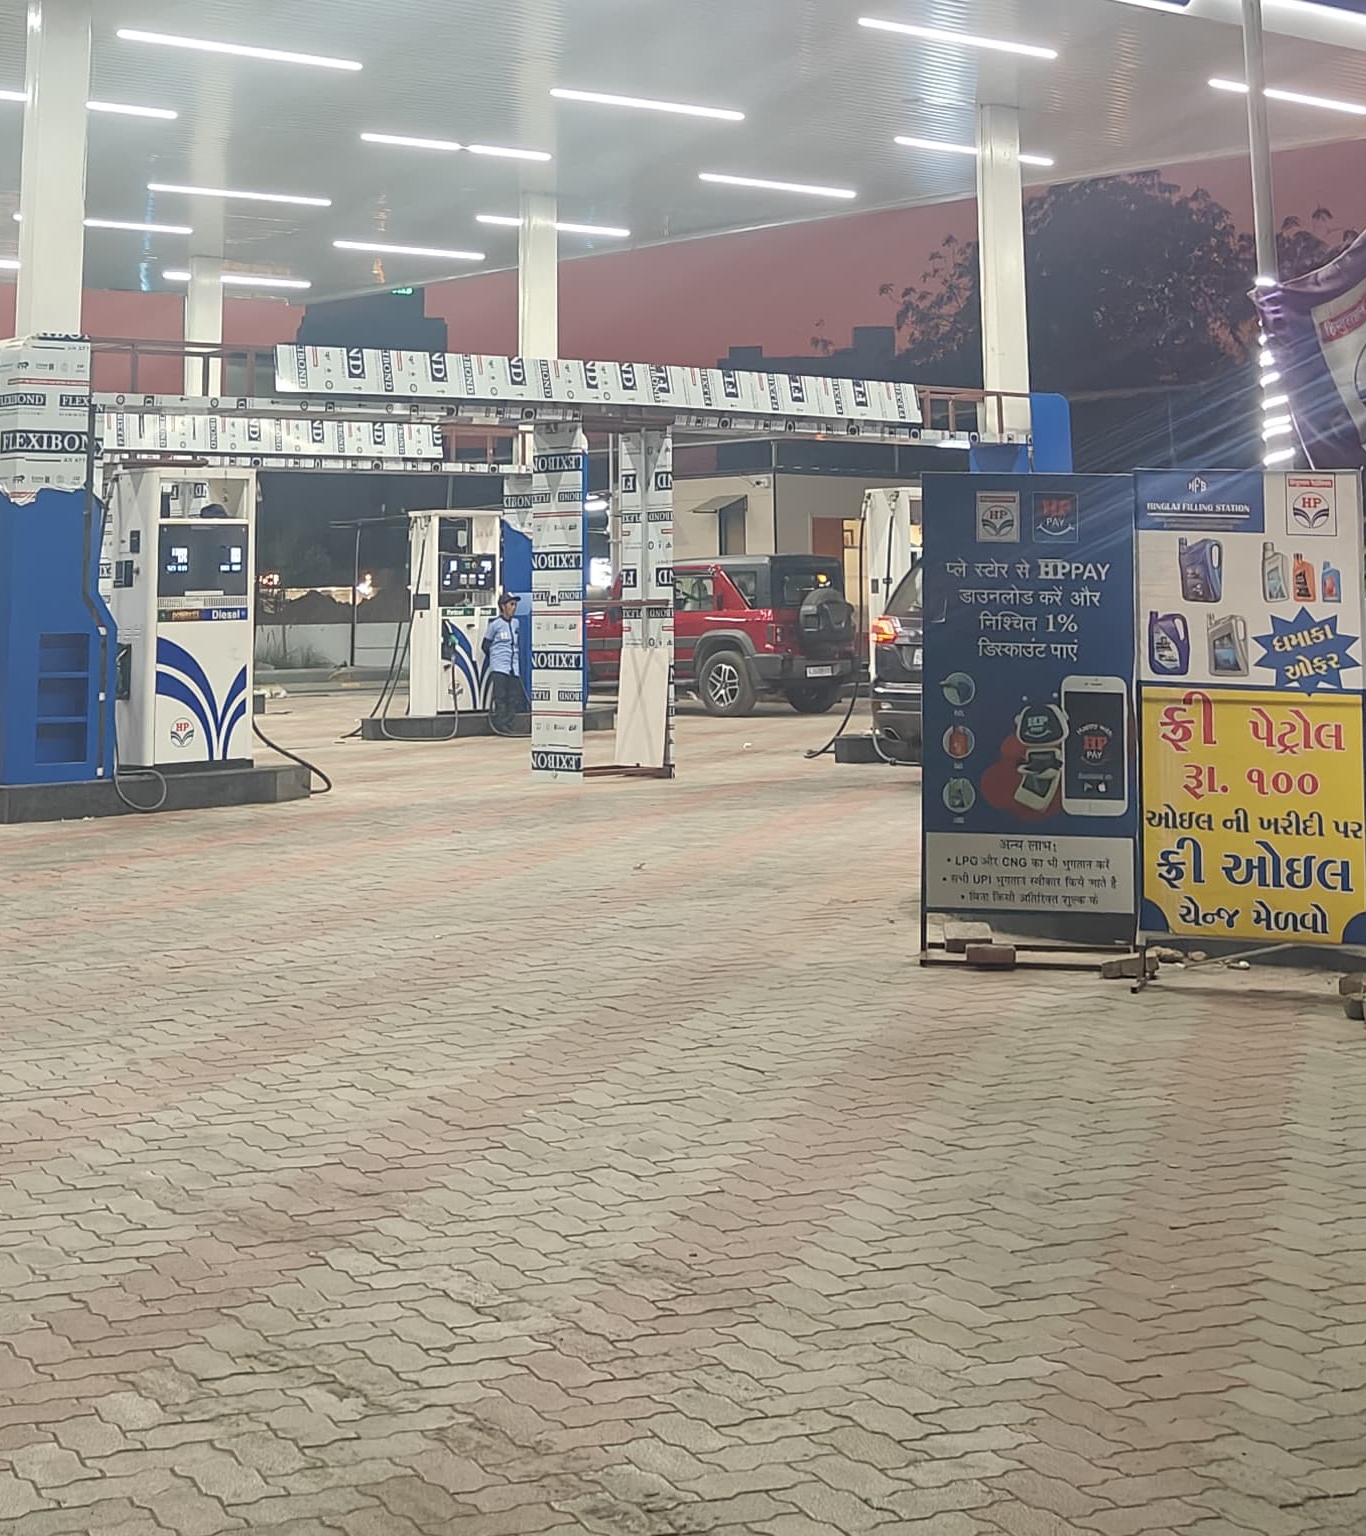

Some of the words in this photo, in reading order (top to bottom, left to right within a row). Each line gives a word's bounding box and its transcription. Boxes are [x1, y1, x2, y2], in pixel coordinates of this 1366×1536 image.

[1182, 502, 1214, 513] FILLING
[1215, 503, 1251, 514] STATION
[1300, 496, 1323, 509] HP
[989, 510, 1008, 520] HP
[1046, 517, 1066, 527] PAY
[946, 557, 968, 578] प्ले
[974, 557, 1009, 579] स्टोर
[1015, 558, 1030, 579] से
[958, 584, 1035, 605] डाउनलोड
[1038, 586, 1063, 606] करें
[1069, 585, 1101, 607] और
[211, 609, 240, 620] Diesel
[978, 610, 1038, 632] निश्चित
[1045, 613, 1079, 633] 1%
[977, 636, 1047, 658] डिस्काउंट
[1050, 638, 1079, 662] पाएं
[1272, 623, 1335, 653] ધમાકા
[1285, 652, 1342, 680] ઓફર
[175, 721, 190, 733] HP
[1159, 690, 1218, 753] ફ્રી
[1248, 706, 1346, 755] પેટ્રોલ
[1086, 750, 1103, 760] PAY
[1246, 767, 1320, 796] ૧૦૦
[1145, 804, 1215, 832] ઓઇલ
[1221, 807, 1251, 834] ની
[1258, 809, 1326, 838] ખરીદી
[1332, 819, 1364, 840] પર
[1000, 838, 1025, 851] अन्य
[955, 855, 979, 867] LPG
[1001, 856, 1028, 869] CNG
[1156, 836, 1206, 890] ફ્રી
[1221, 840, 1355, 893] ઓઇલ
[973, 874, 993, 885] UPI
[1179, 895, 1240, 930] ચેન્જ
[1252, 899, 1330, 935] મેળવો
